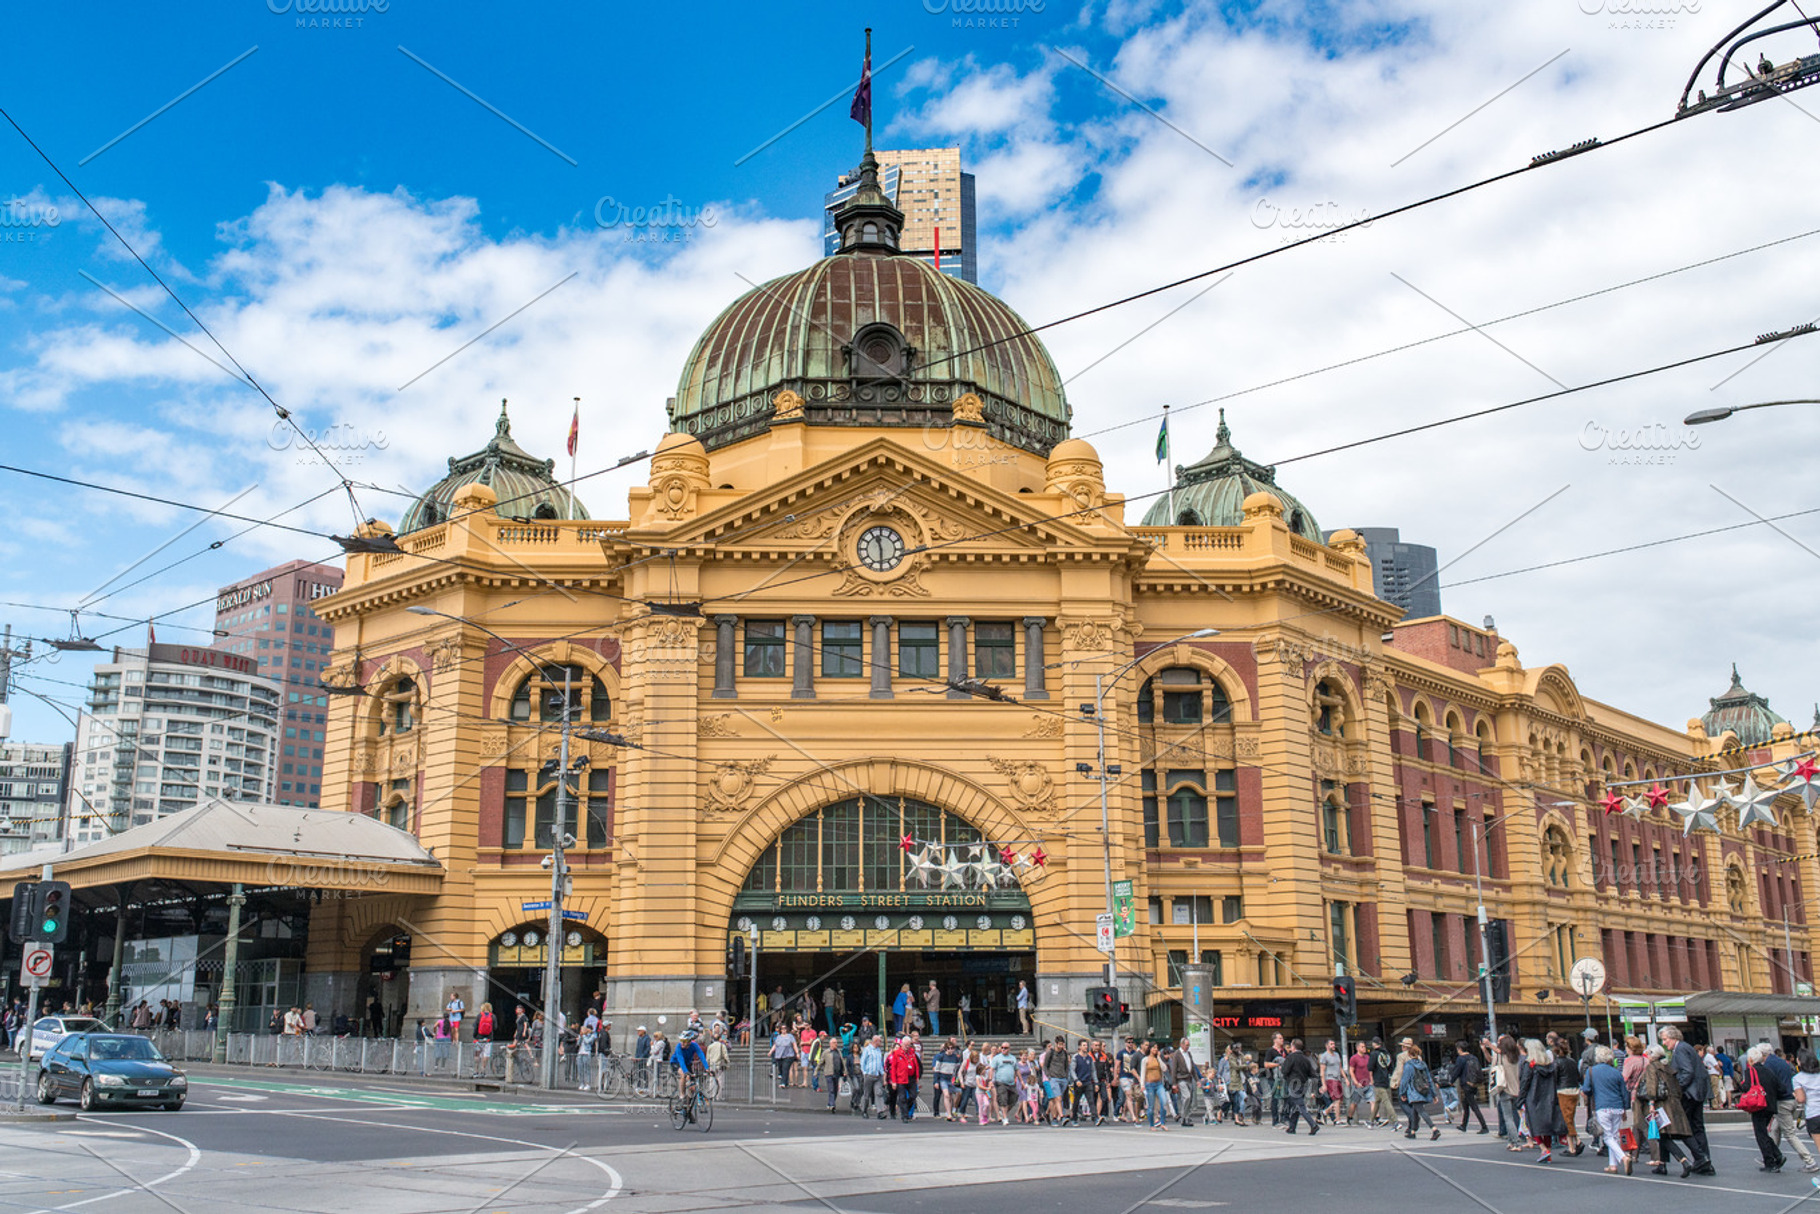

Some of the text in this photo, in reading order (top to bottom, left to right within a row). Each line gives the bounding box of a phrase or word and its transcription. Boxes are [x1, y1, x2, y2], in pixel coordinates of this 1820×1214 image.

[217, 580, 272, 613] HERALD SUN
[181, 648, 250, 673] QUAY WEST
[778, 895, 986, 907] FLINDERS STREET STATION
[1213, 1017, 1282, 1027] CITY HATTERS
